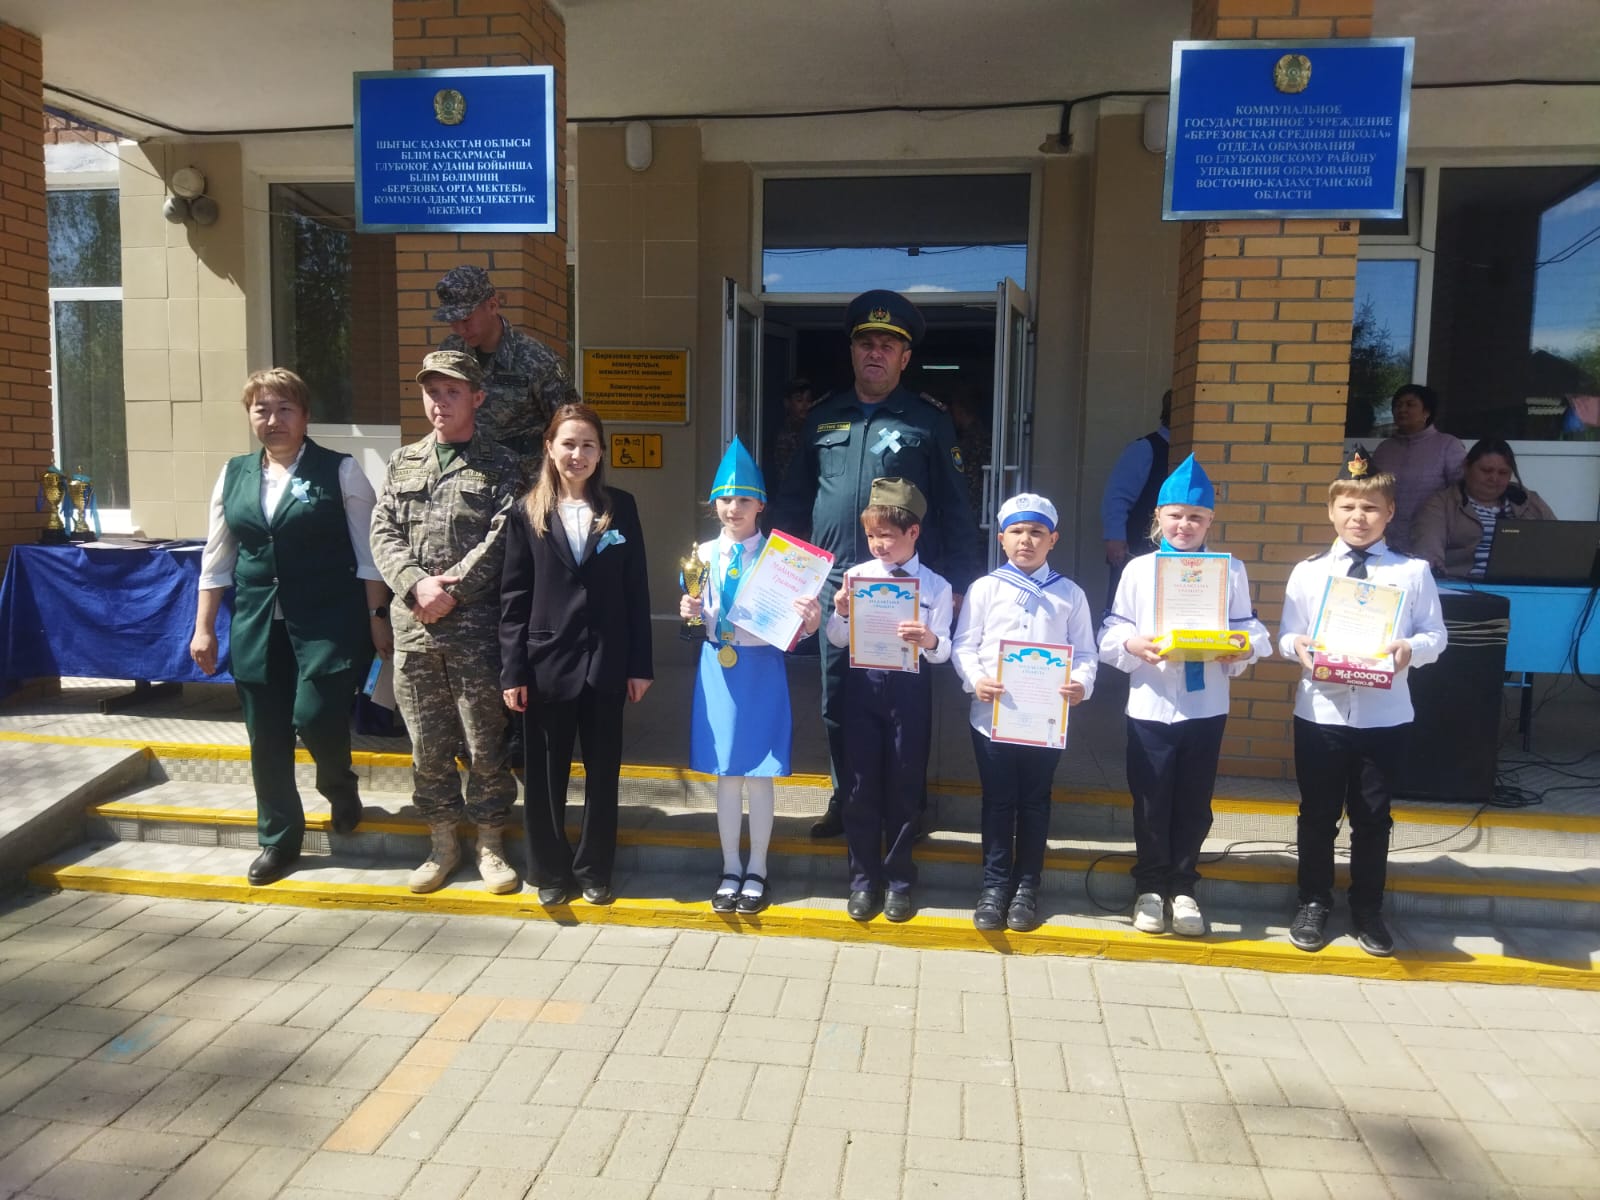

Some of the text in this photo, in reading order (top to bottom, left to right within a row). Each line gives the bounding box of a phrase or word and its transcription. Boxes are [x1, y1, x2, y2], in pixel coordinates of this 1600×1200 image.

[1236, 105, 1342, 115] КОММУНАЛЬНОЕ
[1185, 117, 1392, 128] ГОСУДАРСТВЕННОЕ УЧРЕЖДЕНИЕ
[1184, 129, 1391, 140] «БЕРЕЗОВСКАЯ СРЕДНЯЯ ШКОЛА»
[421, 139, 481, 150] ҚАЗАҚСТАН
[484, 138, 531, 147] ОБЛЫСЫ
[1218, 142, 1356, 152] ОТДЕЛА ОБРАЗОВАНИЯ
[402, 151, 505, 160] БІЛІМ БАСҚАРМАСЫ
[1196, 152, 1376, 164] ПО ГЛУБОКОВСКОМУ РАЙОНУ
[376, 161, 532, 172] ГЛУБОКОЕ АУДАНЫ БОЙЫНША
[1200, 166, 1370, 176] УПРАВЛЕНИЯ ОБРАЗОВАНИЯ
[410, 173, 499, 182] БІЛІМ БӨЛІМІНІҢ
[1196, 176, 1373, 188] ВОСТОЧНО-КАЗАХСТАНСКОЙ
[382, 184, 526, 193] «БЕРЕЗОВКА ОРТА МЕКТЕБІ»
[460, 195, 535, 203] МЕМЛЕКЕТТІК
[1254, 190, 1312, 200] ОБЛАСТИ
[427, 206, 482, 215] МЕКЕМЕСІ
